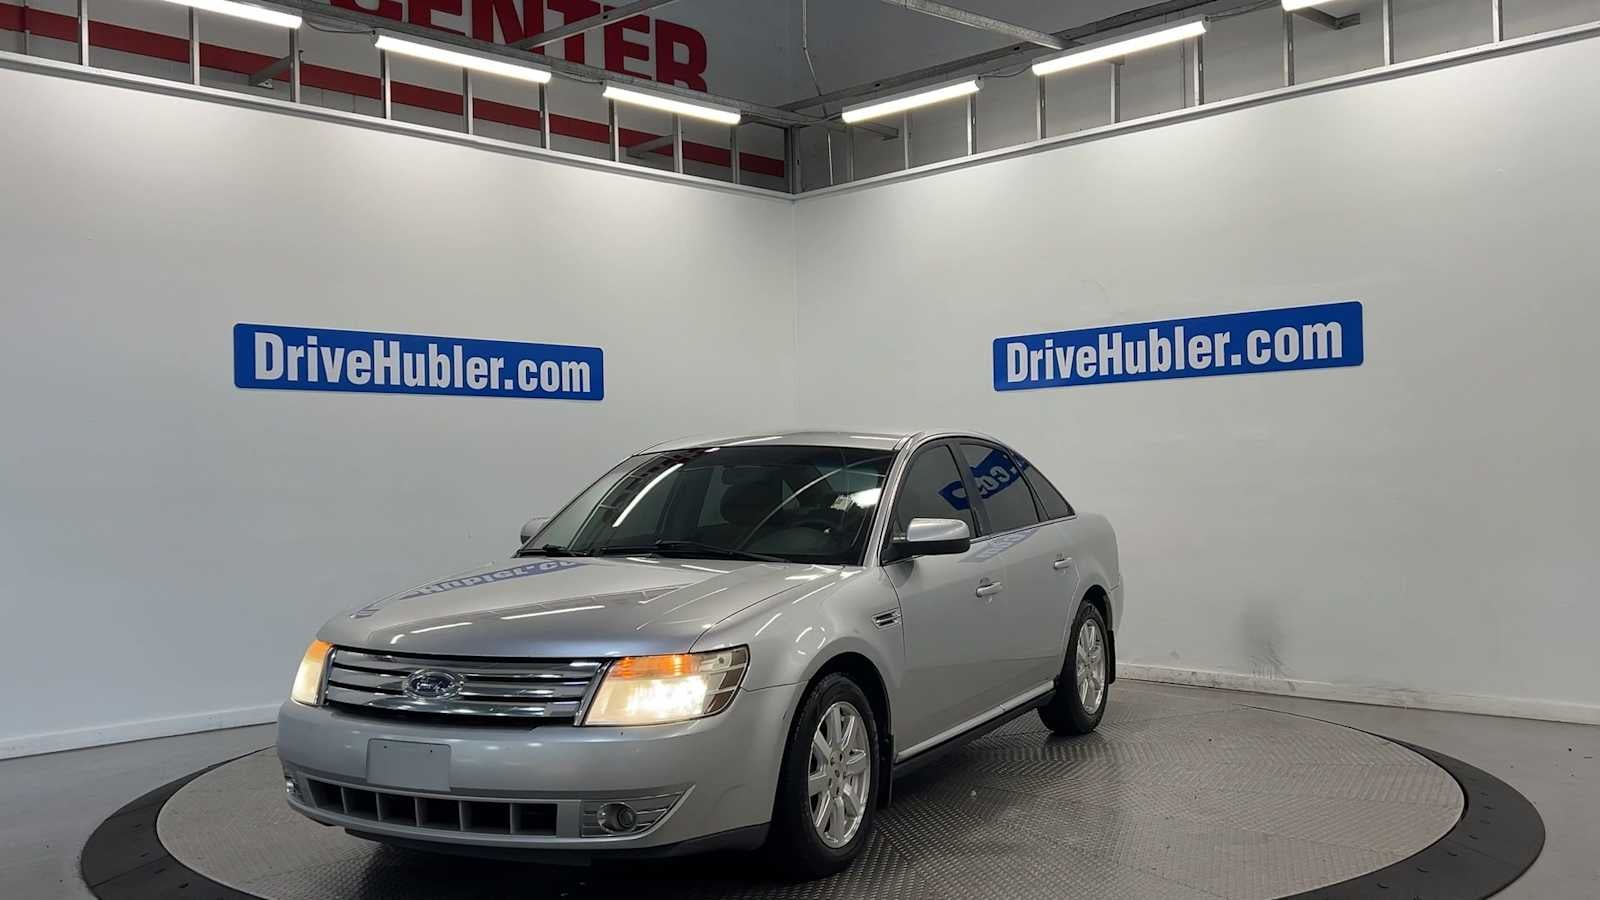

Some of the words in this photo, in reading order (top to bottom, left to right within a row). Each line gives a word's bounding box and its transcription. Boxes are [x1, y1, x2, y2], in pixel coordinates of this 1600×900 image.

[331, 0, 707, 93] NTER
[254, 331, 591, 393] DriveHubler.com
[1007, 320, 1343, 384] DriveHubler.com
